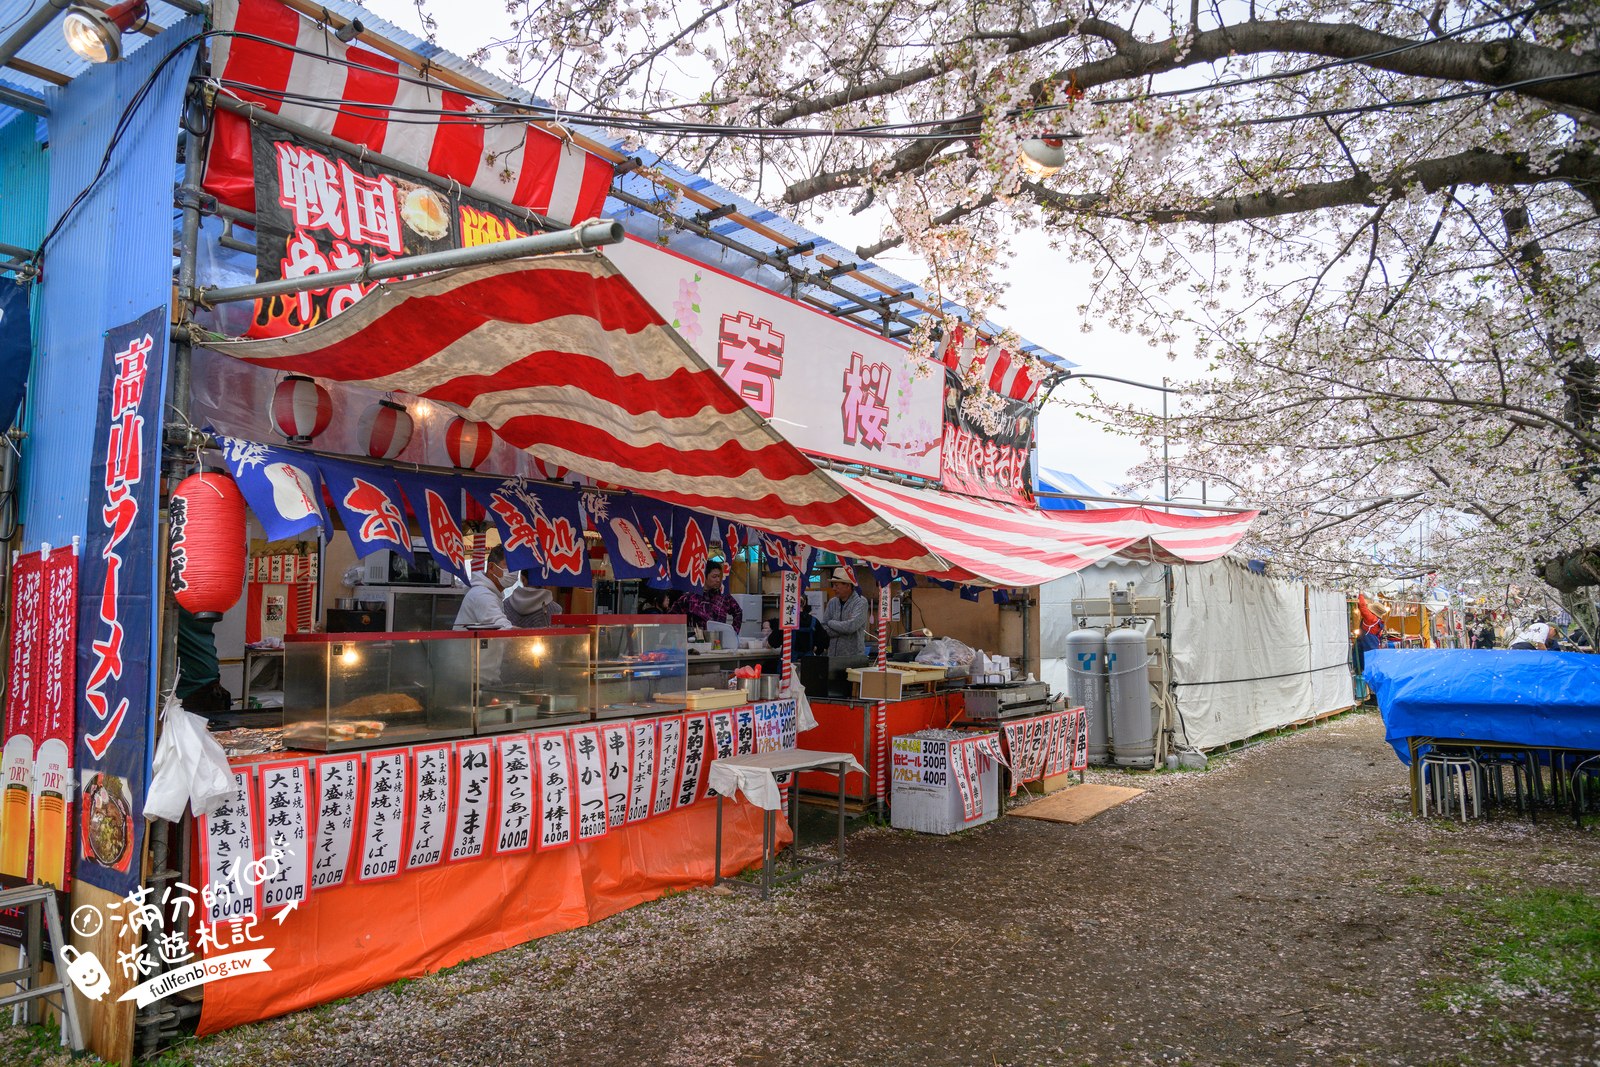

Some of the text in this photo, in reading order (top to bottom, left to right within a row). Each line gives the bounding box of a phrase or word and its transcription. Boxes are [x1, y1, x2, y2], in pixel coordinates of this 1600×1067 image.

[274, 141, 403, 255] 戦国
[718, 311, 892, 450] 若桜
[84, 332, 152, 760] 高山ラーメン
[755, 700, 796, 721] ラムネ 200円
[781, 717, 796, 733] 500円
[782, 733, 796, 749] 400円
[922, 741, 946, 755] 300円
[1028, 722, 1042, 765] おでん
[579, 735, 604, 811] 串かつ
[608, 731, 628, 803] 串かつ
[635, 727, 646, 806] フライドポテト
[659, 723, 673, 798] フライドポテト
[679, 719, 705, 805] 予約承ります
[893, 753, 947, 770] 缶ビール 500円
[392, 755, 403, 820] 目玉焼き付
[438, 749, 448, 813] 目玉焼き付
[463, 749, 489, 835] ねぎま
[504, 743, 530, 828] 大盛からあげ
[542, 740, 569, 821] からあげ棒
[923, 771, 947, 786] 400円
[293, 767, 305, 839] 目玉焼き付
[342, 761, 356, 829] 目玉焼き付
[369, 760, 392, 859] 大盛焼きそば
[416, 755, 437, 850] 大盛焼きそば
[654, 797, 671, 812] 300円
[316, 766, 343, 869] 大盛焼きそば
[580, 811, 606, 823] みそ味
[628, 805, 648, 821] 300円
[462, 836, 475, 846] 3本
[501, 829, 528, 849] 600円
[544, 830, 569, 843] 400円
[580, 822, 606, 838] 4本600円
[410, 850, 440, 866] 600円
[453, 844, 481, 857] 600円
[312, 869, 343, 886] 600円
[364, 860, 397, 876] 600円
[212, 897, 253, 918] 600円
[266, 885, 304, 904] 600円
